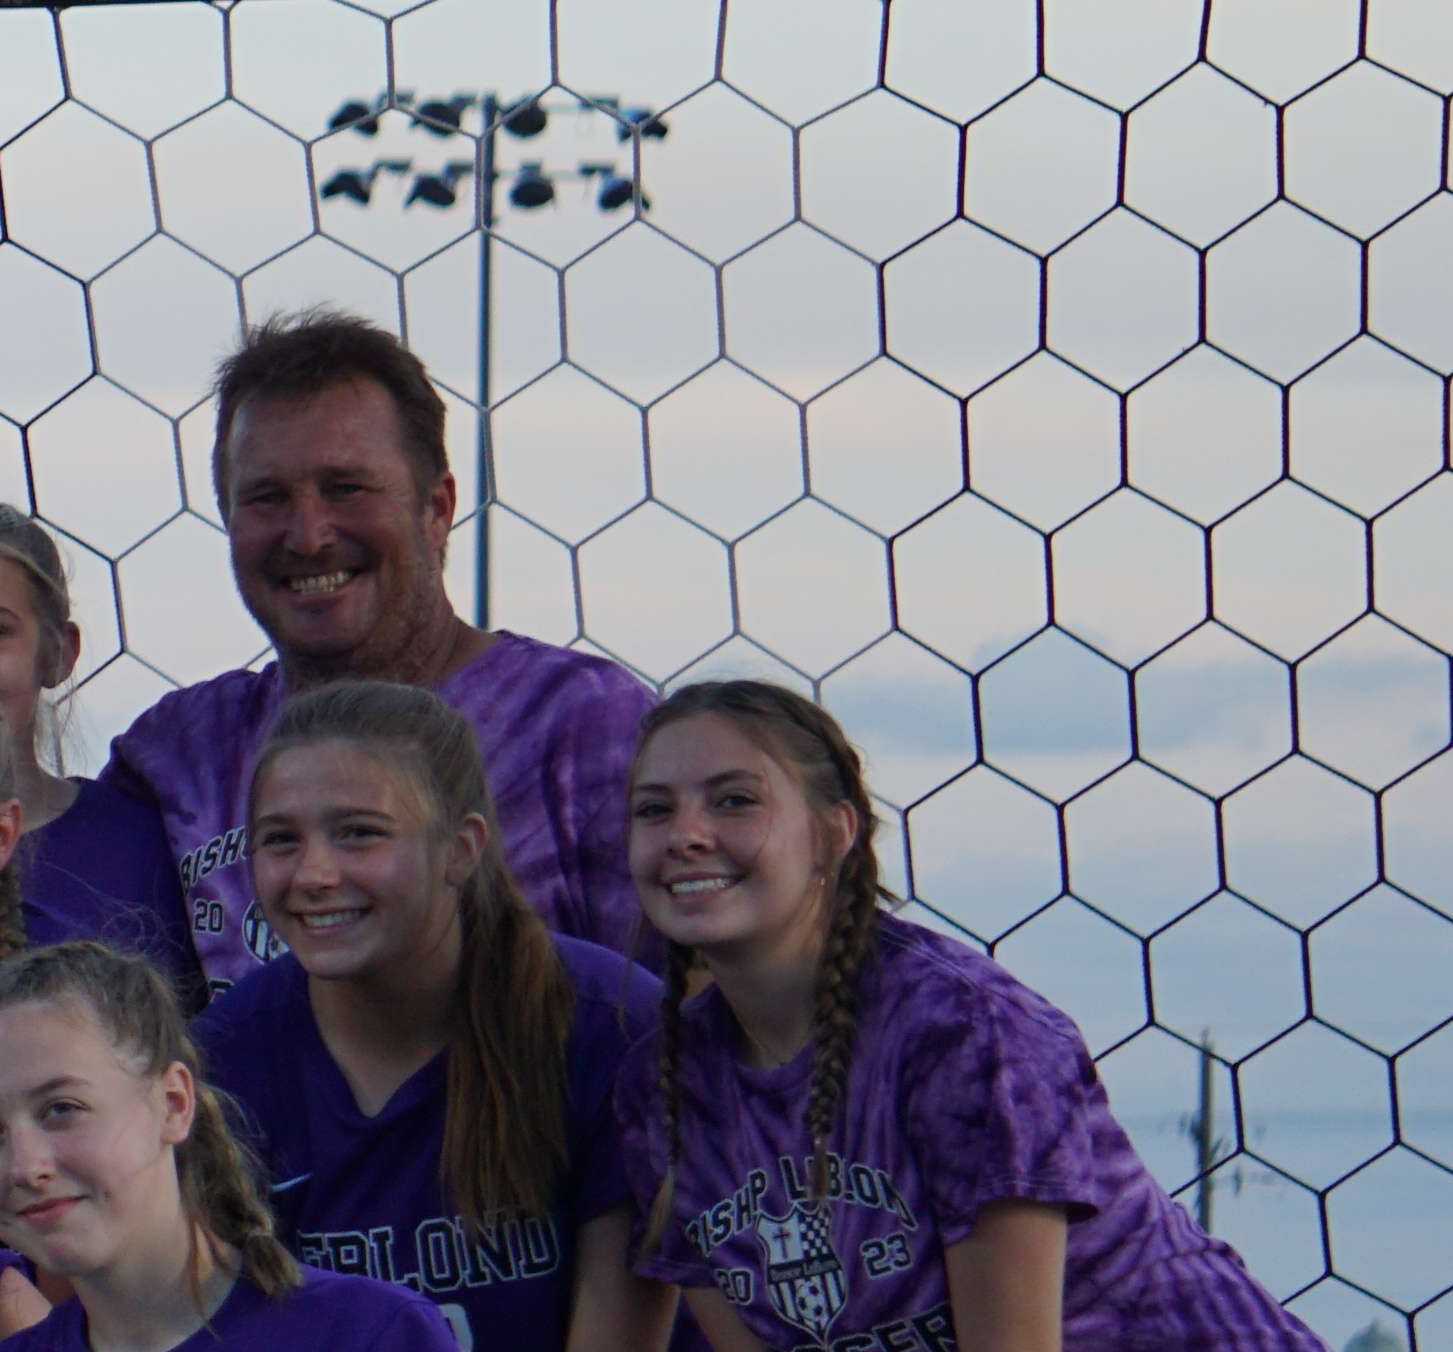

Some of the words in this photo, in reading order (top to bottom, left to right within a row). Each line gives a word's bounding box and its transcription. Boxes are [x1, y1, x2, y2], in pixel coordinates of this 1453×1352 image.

[179, 825, 248, 897] BISH
[193, 897, 224, 936] 20
[860, 1230, 915, 1281] 23
